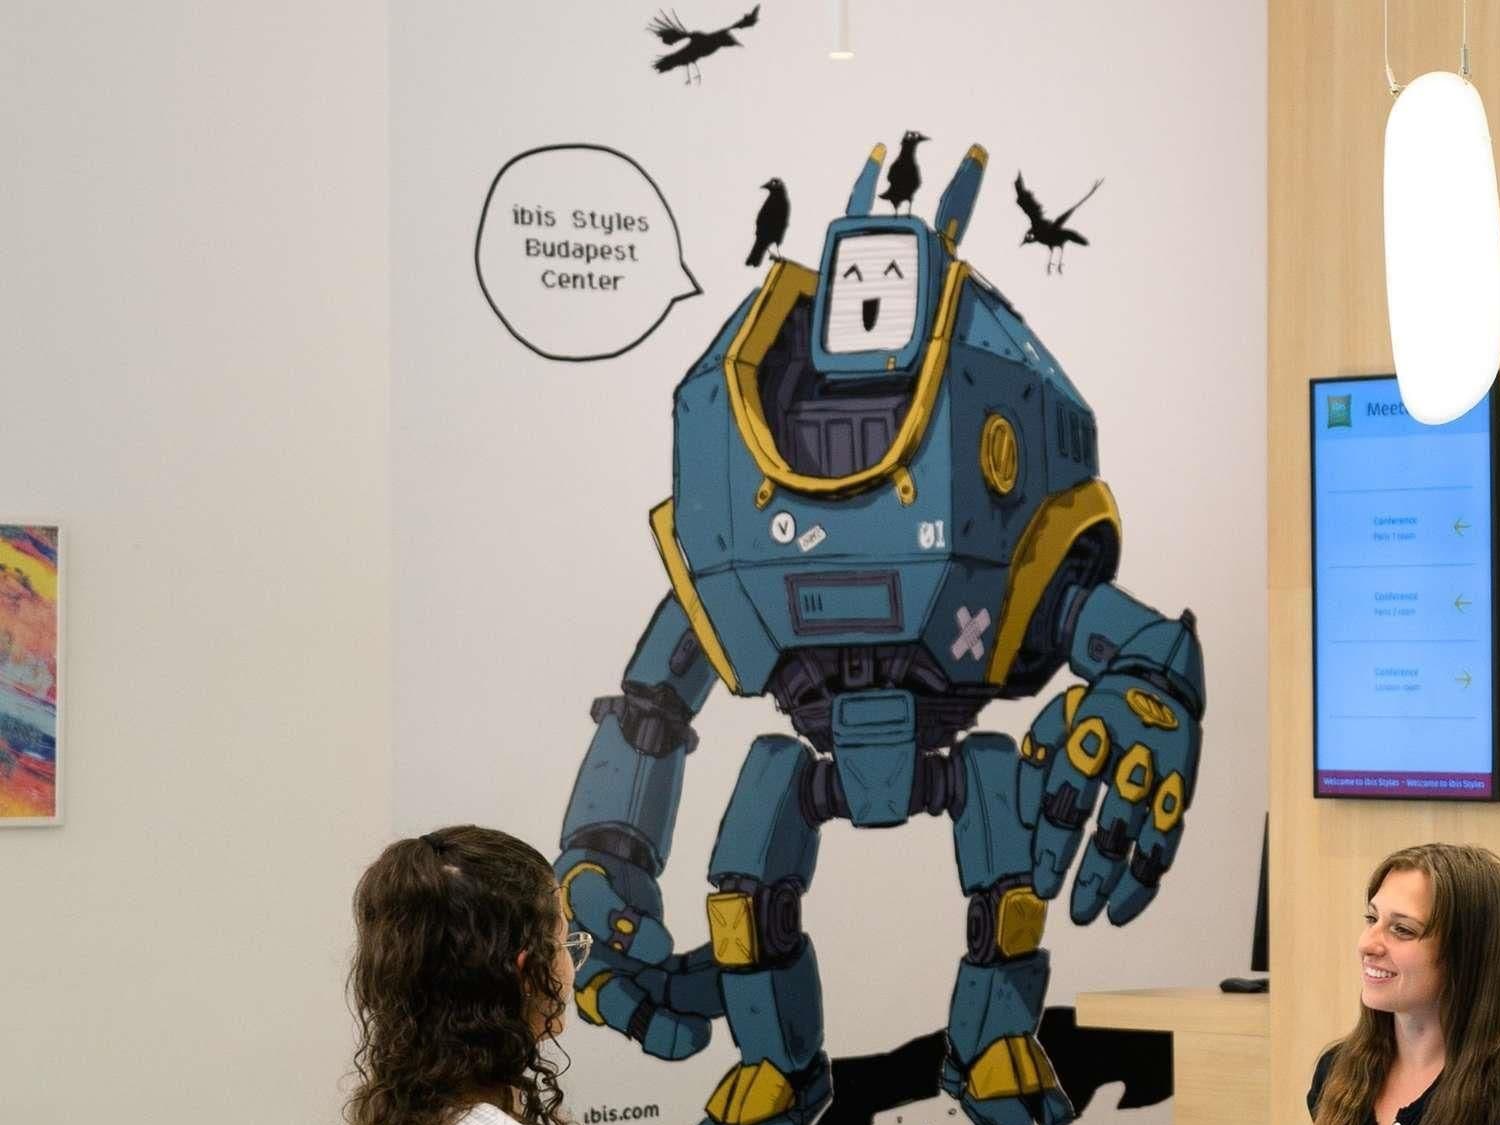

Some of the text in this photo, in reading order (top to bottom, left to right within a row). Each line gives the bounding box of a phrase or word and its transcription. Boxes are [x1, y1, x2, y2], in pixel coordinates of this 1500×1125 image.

[512, 204, 650, 235] ibis Styles
[525, 238, 638, 263] Budapest
[541, 270, 626, 290] Center
[1367, 401, 1409, 417] Meet
[778, 521, 789, 536] V
[1323, 776, 1354, 786] Welcome
[1377, 777, 1400, 789] Styles
[1406, 779, 1439, 788] Welcome
[1462, 780, 1485, 790] Styles
